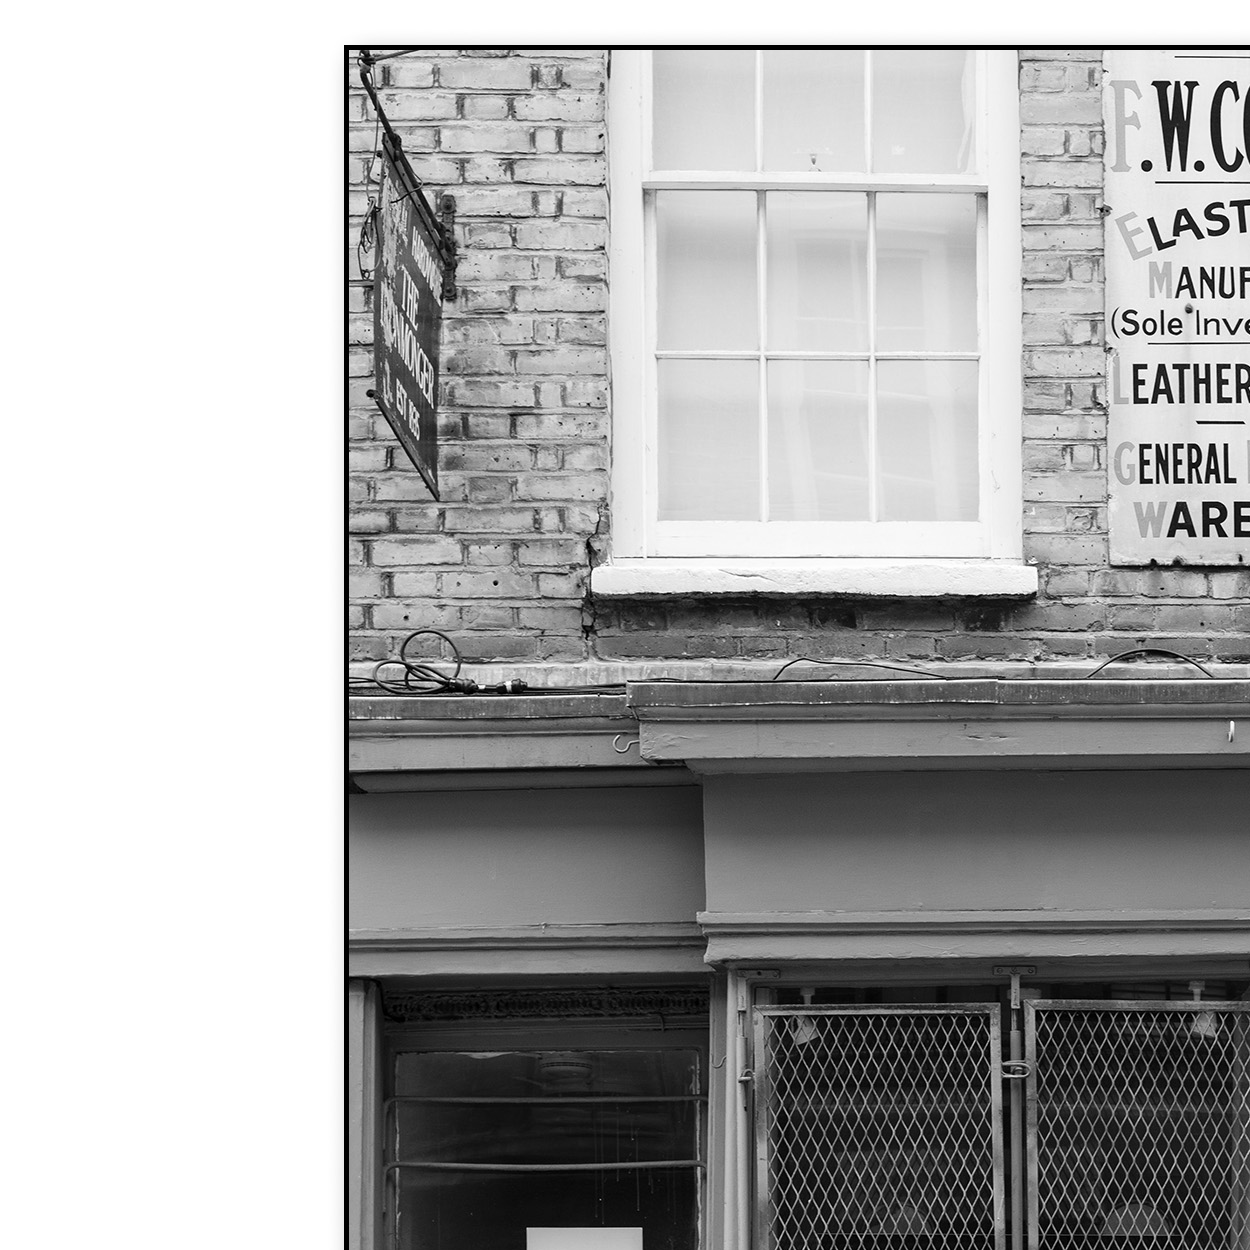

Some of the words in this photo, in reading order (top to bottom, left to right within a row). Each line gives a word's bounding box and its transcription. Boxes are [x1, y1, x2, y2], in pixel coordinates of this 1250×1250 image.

[412, 225, 442, 307] HARDWE
[402, 264, 419, 331] THE
[1111, 306, 1183, 339] (Sole
[1114, 441, 1237, 485] GENERAL
